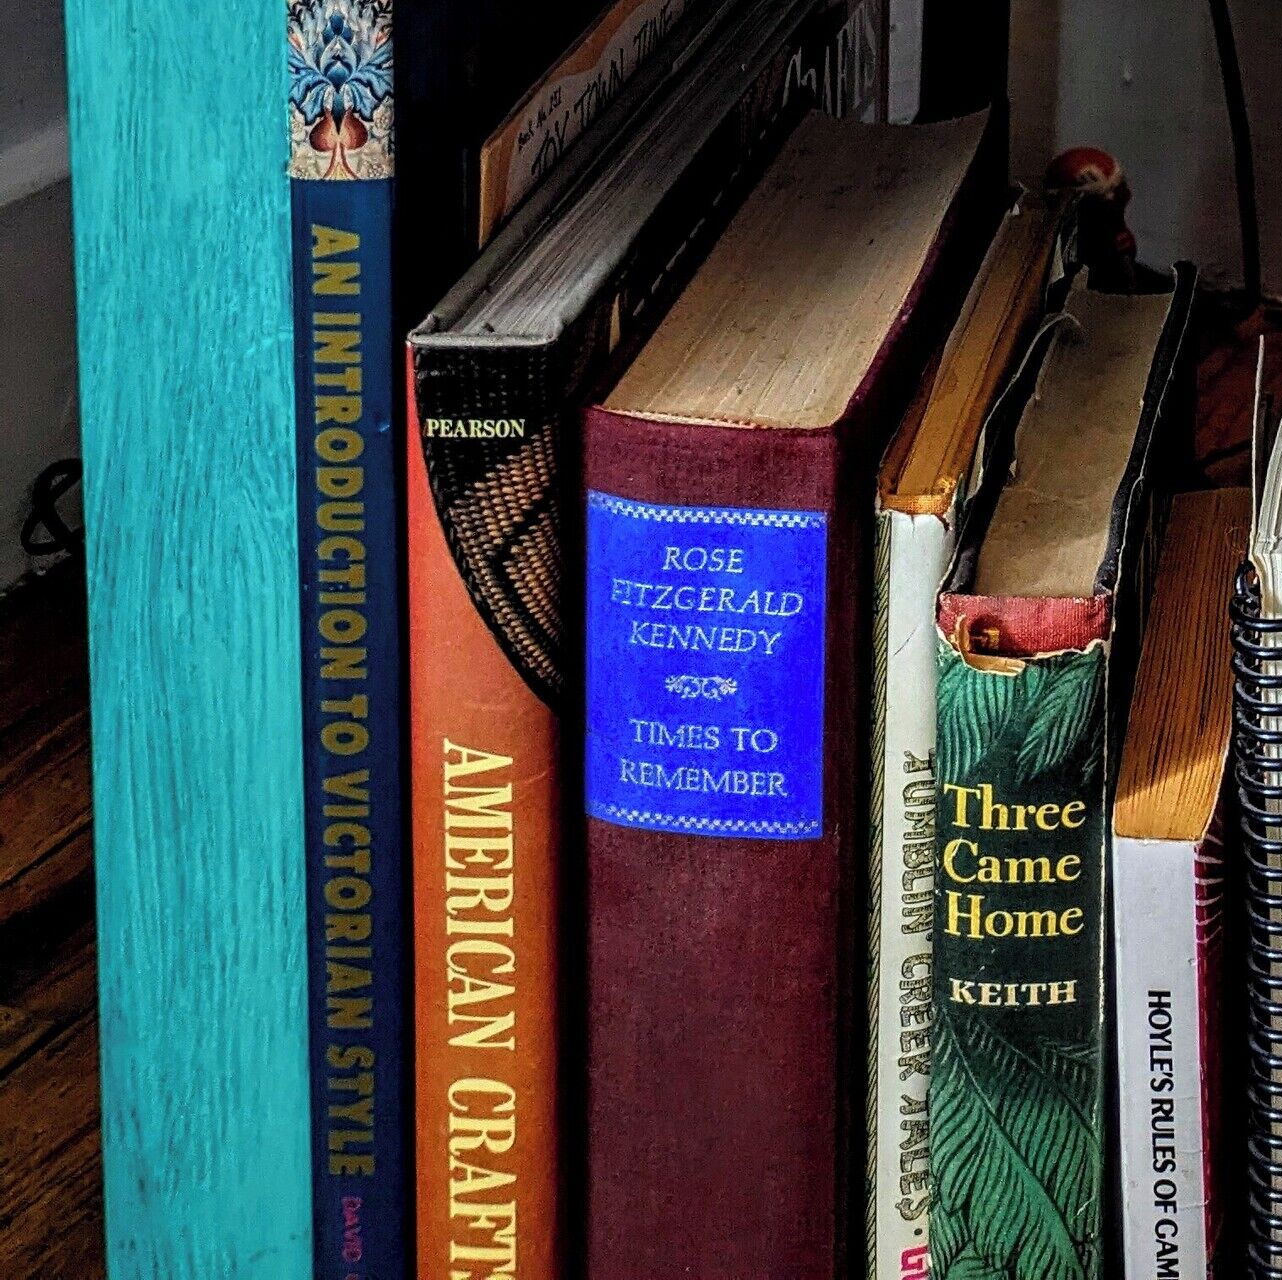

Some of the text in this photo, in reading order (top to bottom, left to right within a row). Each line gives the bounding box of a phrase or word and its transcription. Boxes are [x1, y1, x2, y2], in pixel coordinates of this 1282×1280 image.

[426, 417, 526, 439] PEARSON
[664, 547, 744, 574] ROSE
[610, 578, 804, 617] FITZGERALD
[629, 621, 782, 656] KENNEDY
[311, 224, 377, 1175] AN INTRODUCTION TO VICTORIAN STYLE
[629, 718, 778, 754] TIMES TO
[619, 760, 788, 798] REMEMBER
[944, 782, 1086, 830] Three
[943, 838, 1081, 885] Came
[943, 892, 1084, 939] Home
[443, 738, 518, 1280] AMERICAN CRAFT
[949, 977, 1078, 1007] KEITH
[1147, 990, 1180, 1280] HOYLE'S RULES OF GAM
